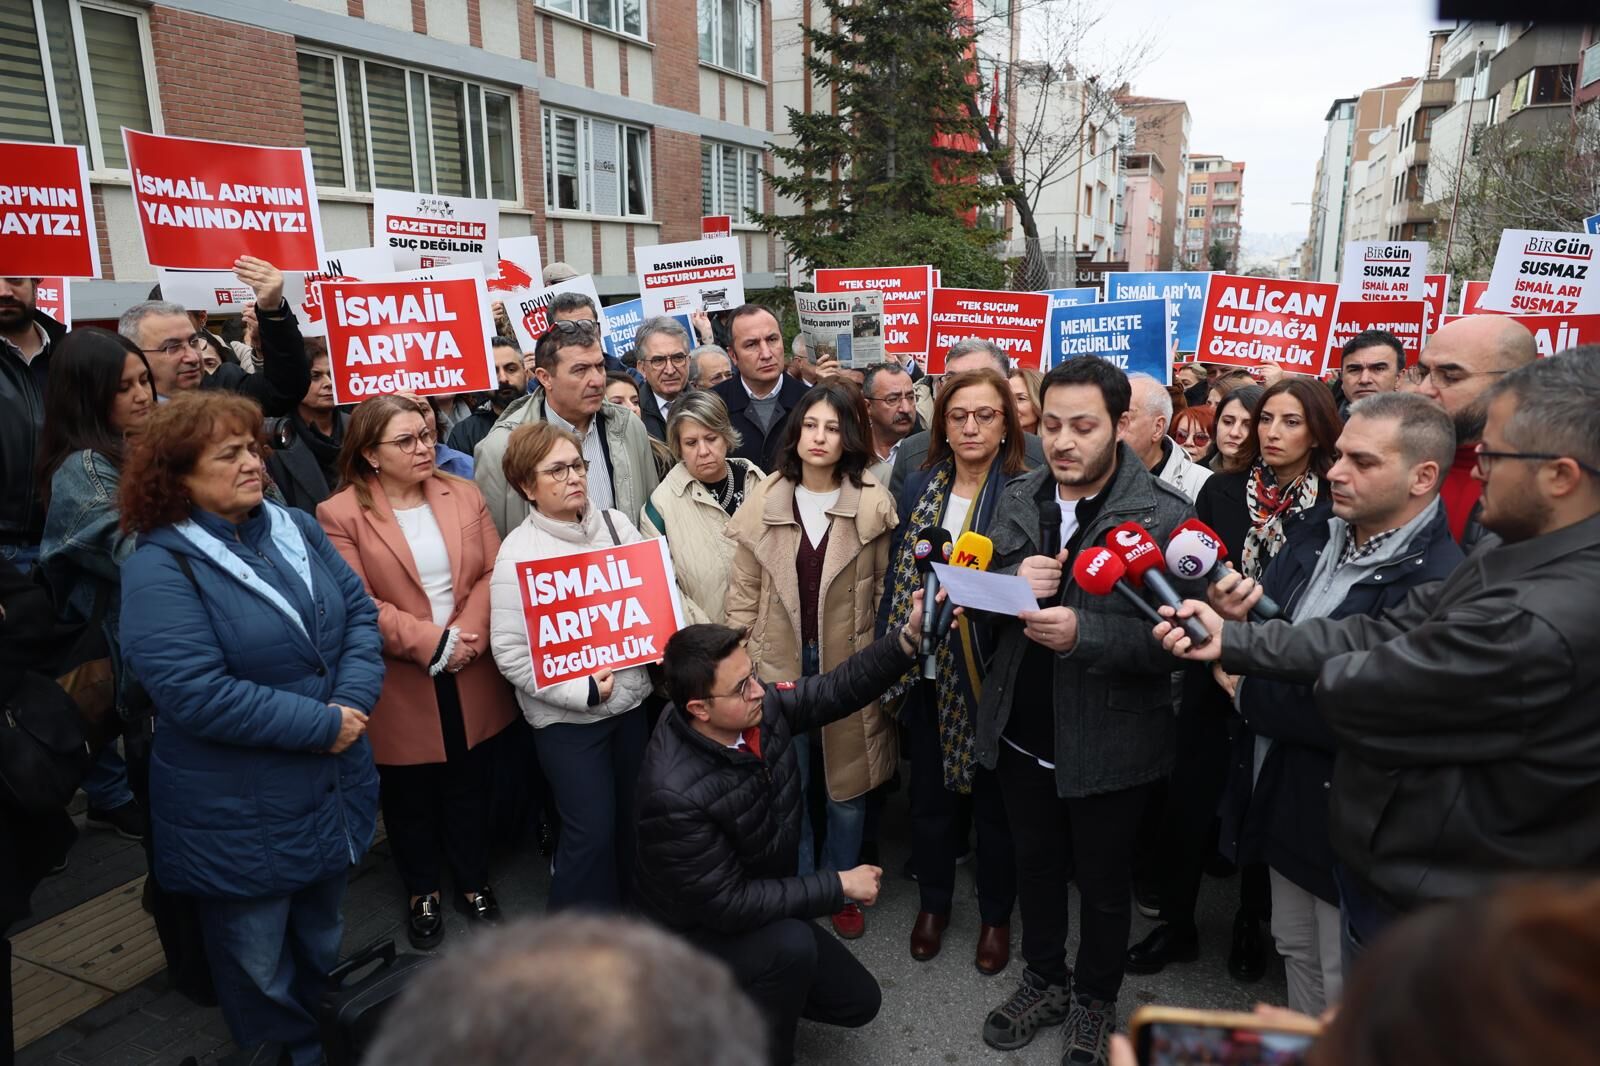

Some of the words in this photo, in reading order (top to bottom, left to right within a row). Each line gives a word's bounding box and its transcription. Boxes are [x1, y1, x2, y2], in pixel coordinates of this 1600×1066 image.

[0, 186, 77, 207] RI’NIN
[136, 168, 213, 200] İSMAİL
[218, 183, 303, 206] ARI’NIN
[0, 212, 81, 236] AYIZ!
[141, 201, 307, 233] YANINDAYIZ!
[388, 219, 484, 237] GAZETECİLİK
[389, 238, 418, 251] SUÇ
[420, 239, 483, 253] DEĞİLDİR
[653, 260, 683, 271] BASIN
[684, 254, 723, 267] HÜRDÜR
[1363, 266, 1411, 278] SUSMAZ
[1520, 261, 1588, 280] SUSMAZ
[646, 267, 734, 286] SUSTURULAMAZ
[839, 280, 864, 289] “TEK
[865, 279, 901, 289] SUÇUM
[1362, 280, 1389, 291] İSMAİL
[1391, 283, 1408, 292] ARI
[1116, 283, 1159, 300] İSMAİL
[1162, 282, 1202, 300] ARI’YA
[1515, 278, 1554, 295] İSMAİL
[1557, 285, 1582, 298] ARI
[335, 288, 458, 327] İSMAİL
[957, 300, 982, 311] “TEK
[983, 302, 1019, 313] SUÇUM
[1217, 284, 1327, 318] ALİCAN
[1510, 295, 1578, 314] SUSMAZ
[606, 309, 642, 329] İSMAİL
[884, 313, 920, 326] RI’YA
[932, 312, 993, 324] GAZETECİLİK
[996, 316, 1044, 328] YAPMAK”
[1060, 314, 1142, 336] MEMLEKETE
[1213, 314, 1318, 342] ULUDAĞ’A
[346, 330, 463, 367] ARI’YA
[1061, 332, 1131, 355] ÖZGÜRLÜK
[1209, 336, 1315, 366] ÖZGÜRLÜK
[349, 366, 467, 396] ÖZGÜRLÜK
[1124, 541, 1154, 560] anka
[1086, 549, 1112, 577] NOW
[525, 554, 643, 607] İSMAİL
[539, 597, 651, 648] ARI’YA
[542, 635, 657, 679] ÖZGÜRLÜK
